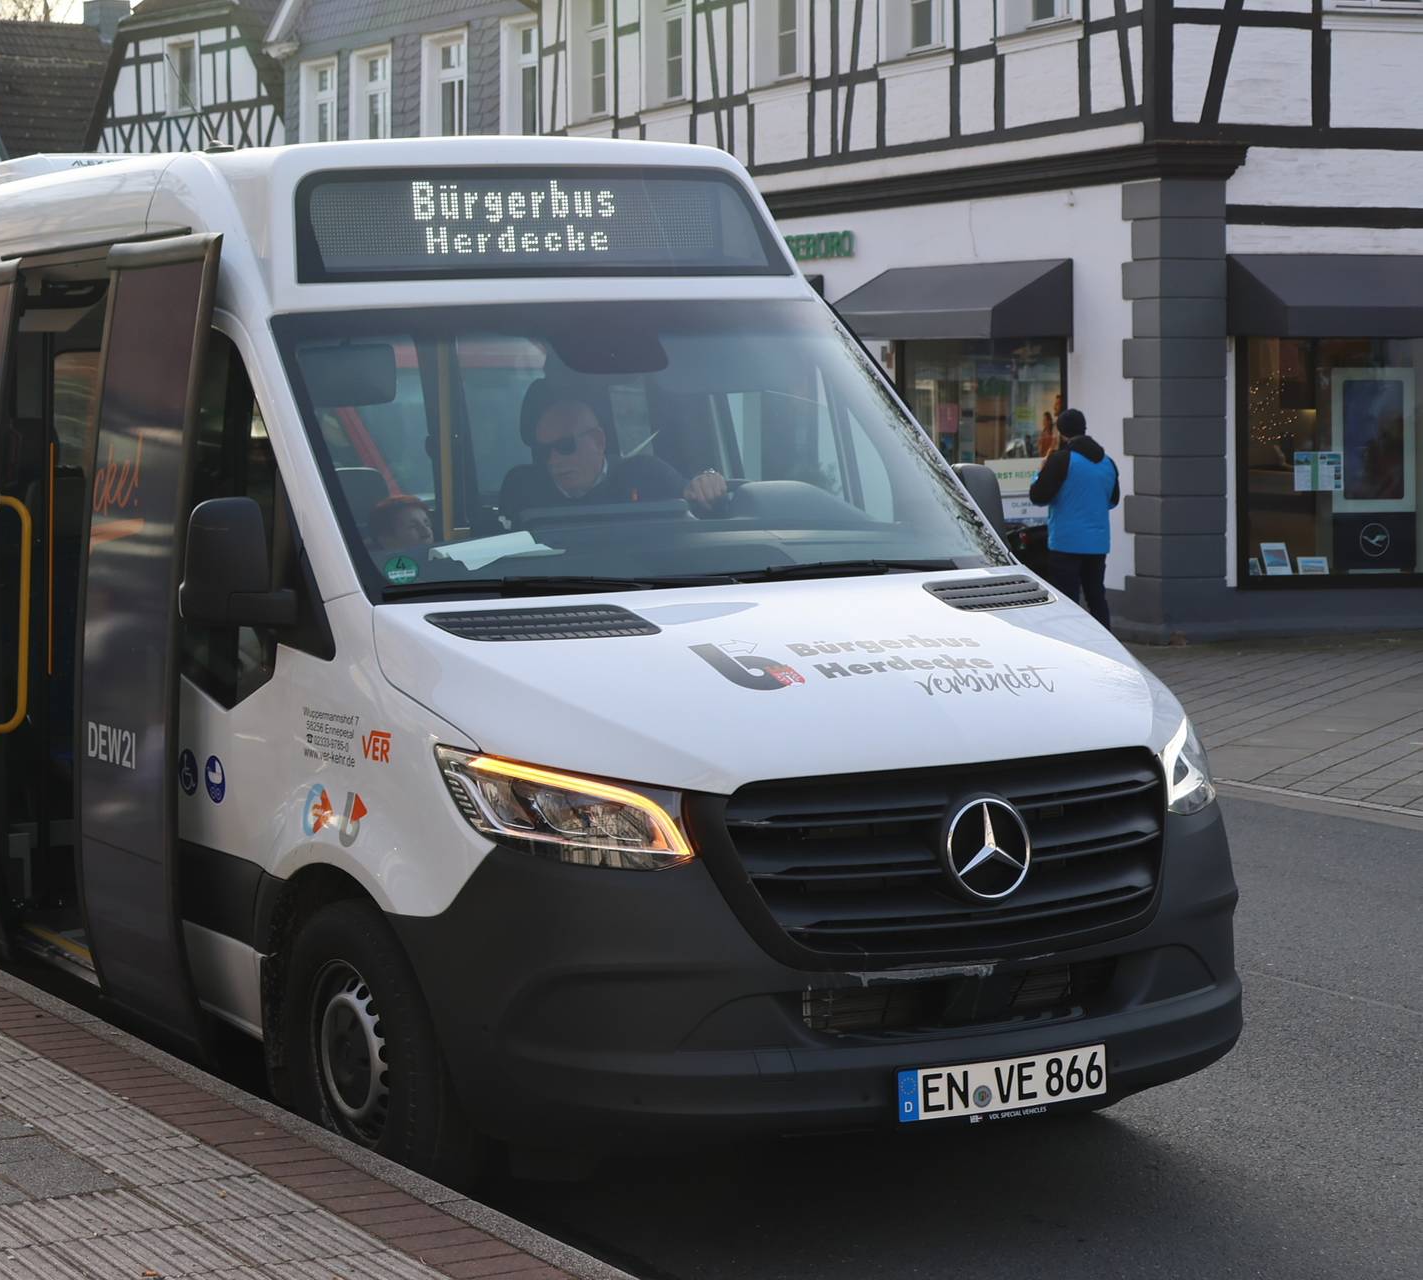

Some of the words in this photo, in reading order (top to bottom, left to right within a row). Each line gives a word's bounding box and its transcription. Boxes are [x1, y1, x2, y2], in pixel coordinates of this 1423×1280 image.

[412, 180, 616, 223] Bürgerbus
[426, 225, 609, 254] Herdecke
[785, 635, 982, 658] Bürgerbus
[812, 653, 995, 680] Herdecke
[914, 663, 1061, 697] verbindet
[325, 723, 355, 740] Ennepetal
[362, 730, 393, 764] VER
[904, 1101, 914, 1113] D
[922, 1070, 970, 1113] EN
[994, 1061, 1038, 1104] VE
[1045, 1051, 1104, 1098] 866
